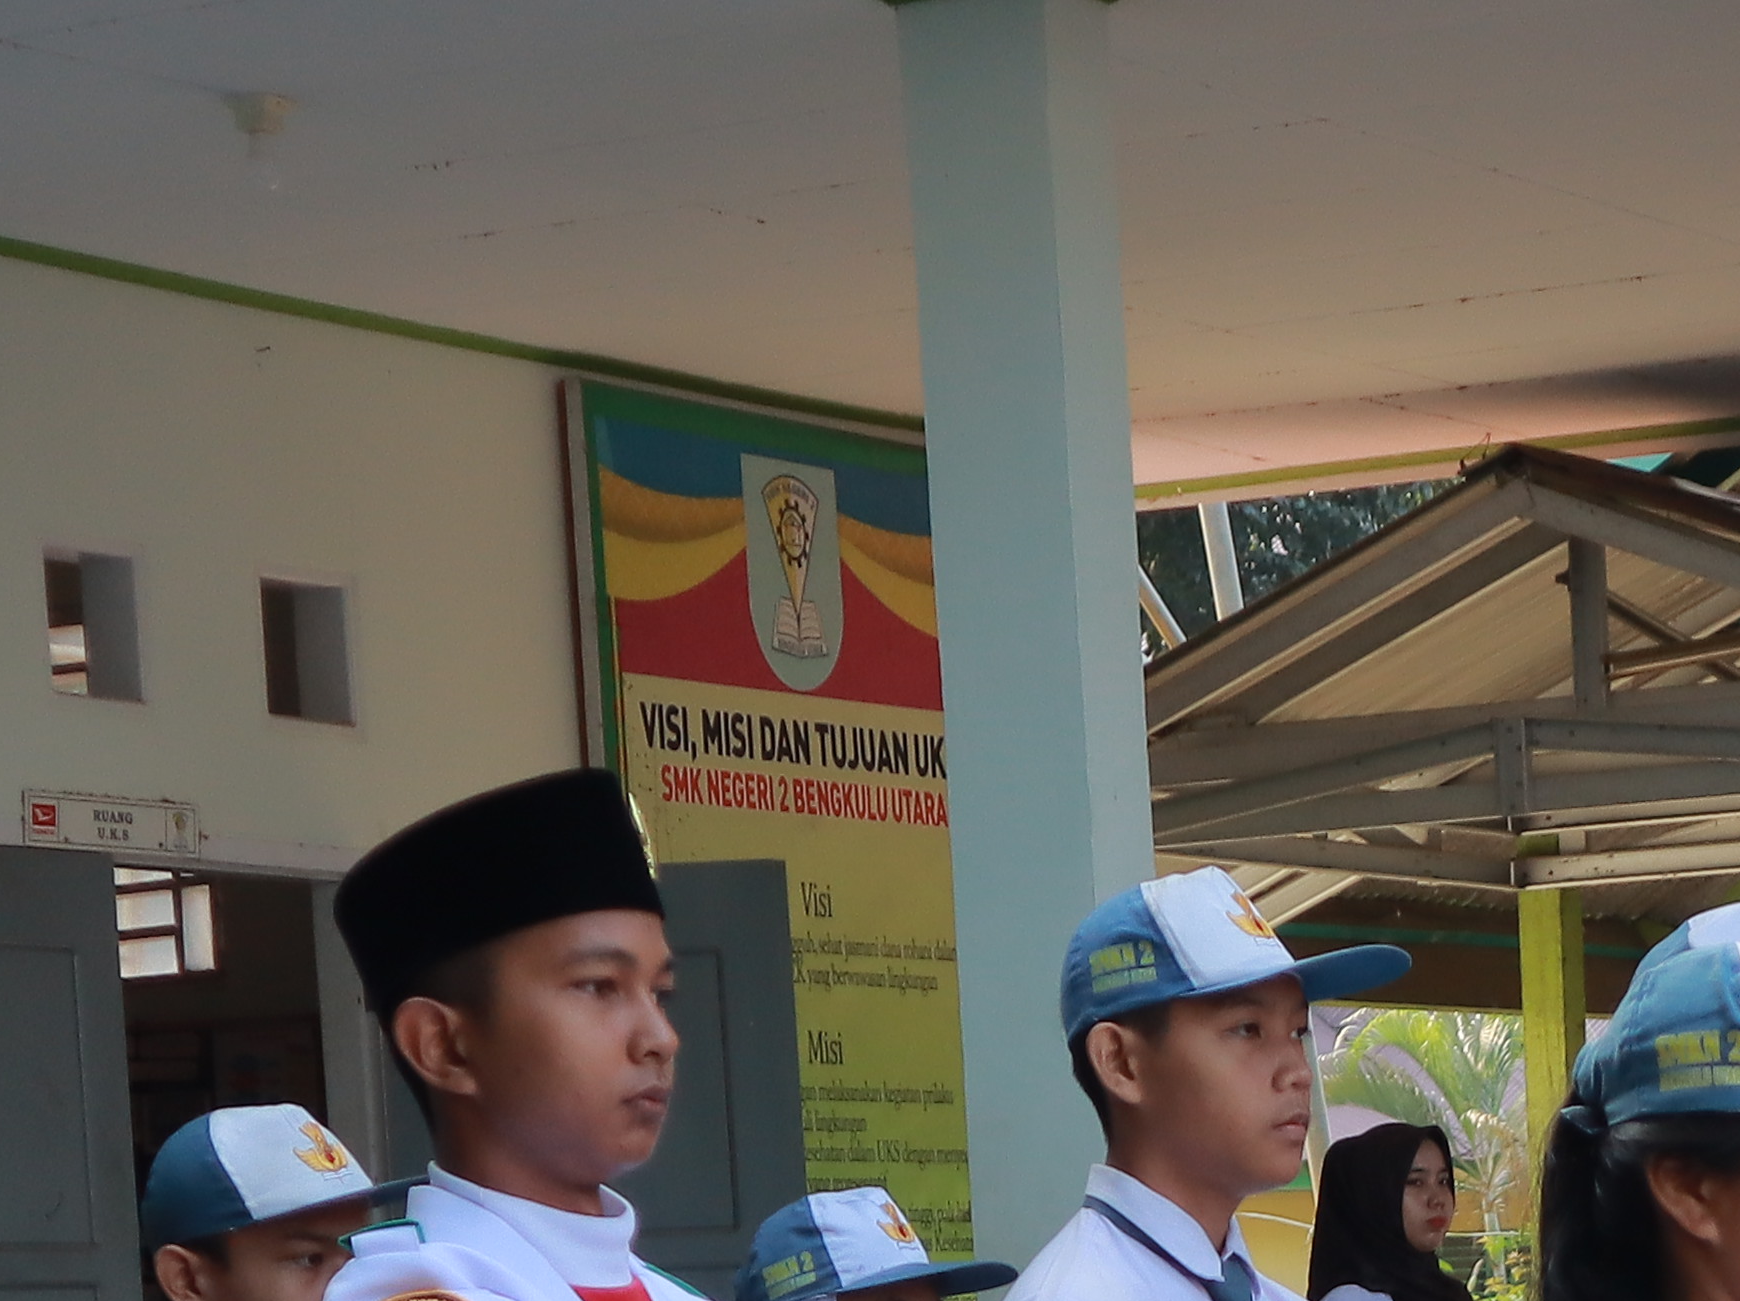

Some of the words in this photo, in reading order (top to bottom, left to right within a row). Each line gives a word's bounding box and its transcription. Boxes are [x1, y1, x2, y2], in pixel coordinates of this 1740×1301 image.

[639, 701, 697, 762] VISI,
[701, 708, 754, 760] MISI
[759, 715, 811, 765] DAN
[814, 722, 910, 776] TUJUAN
[661, 764, 703, 805] SMK
[707, 769, 775, 812] NEGERI
[778, 775, 790, 814] 2
[792, 778, 888, 822] BENGKULU
[891, 788, 949, 828] UTARA
[92, 809, 134, 825] RUANG
[801, 881, 833, 918] Visi
[807, 1029, 844, 1065] Misi
